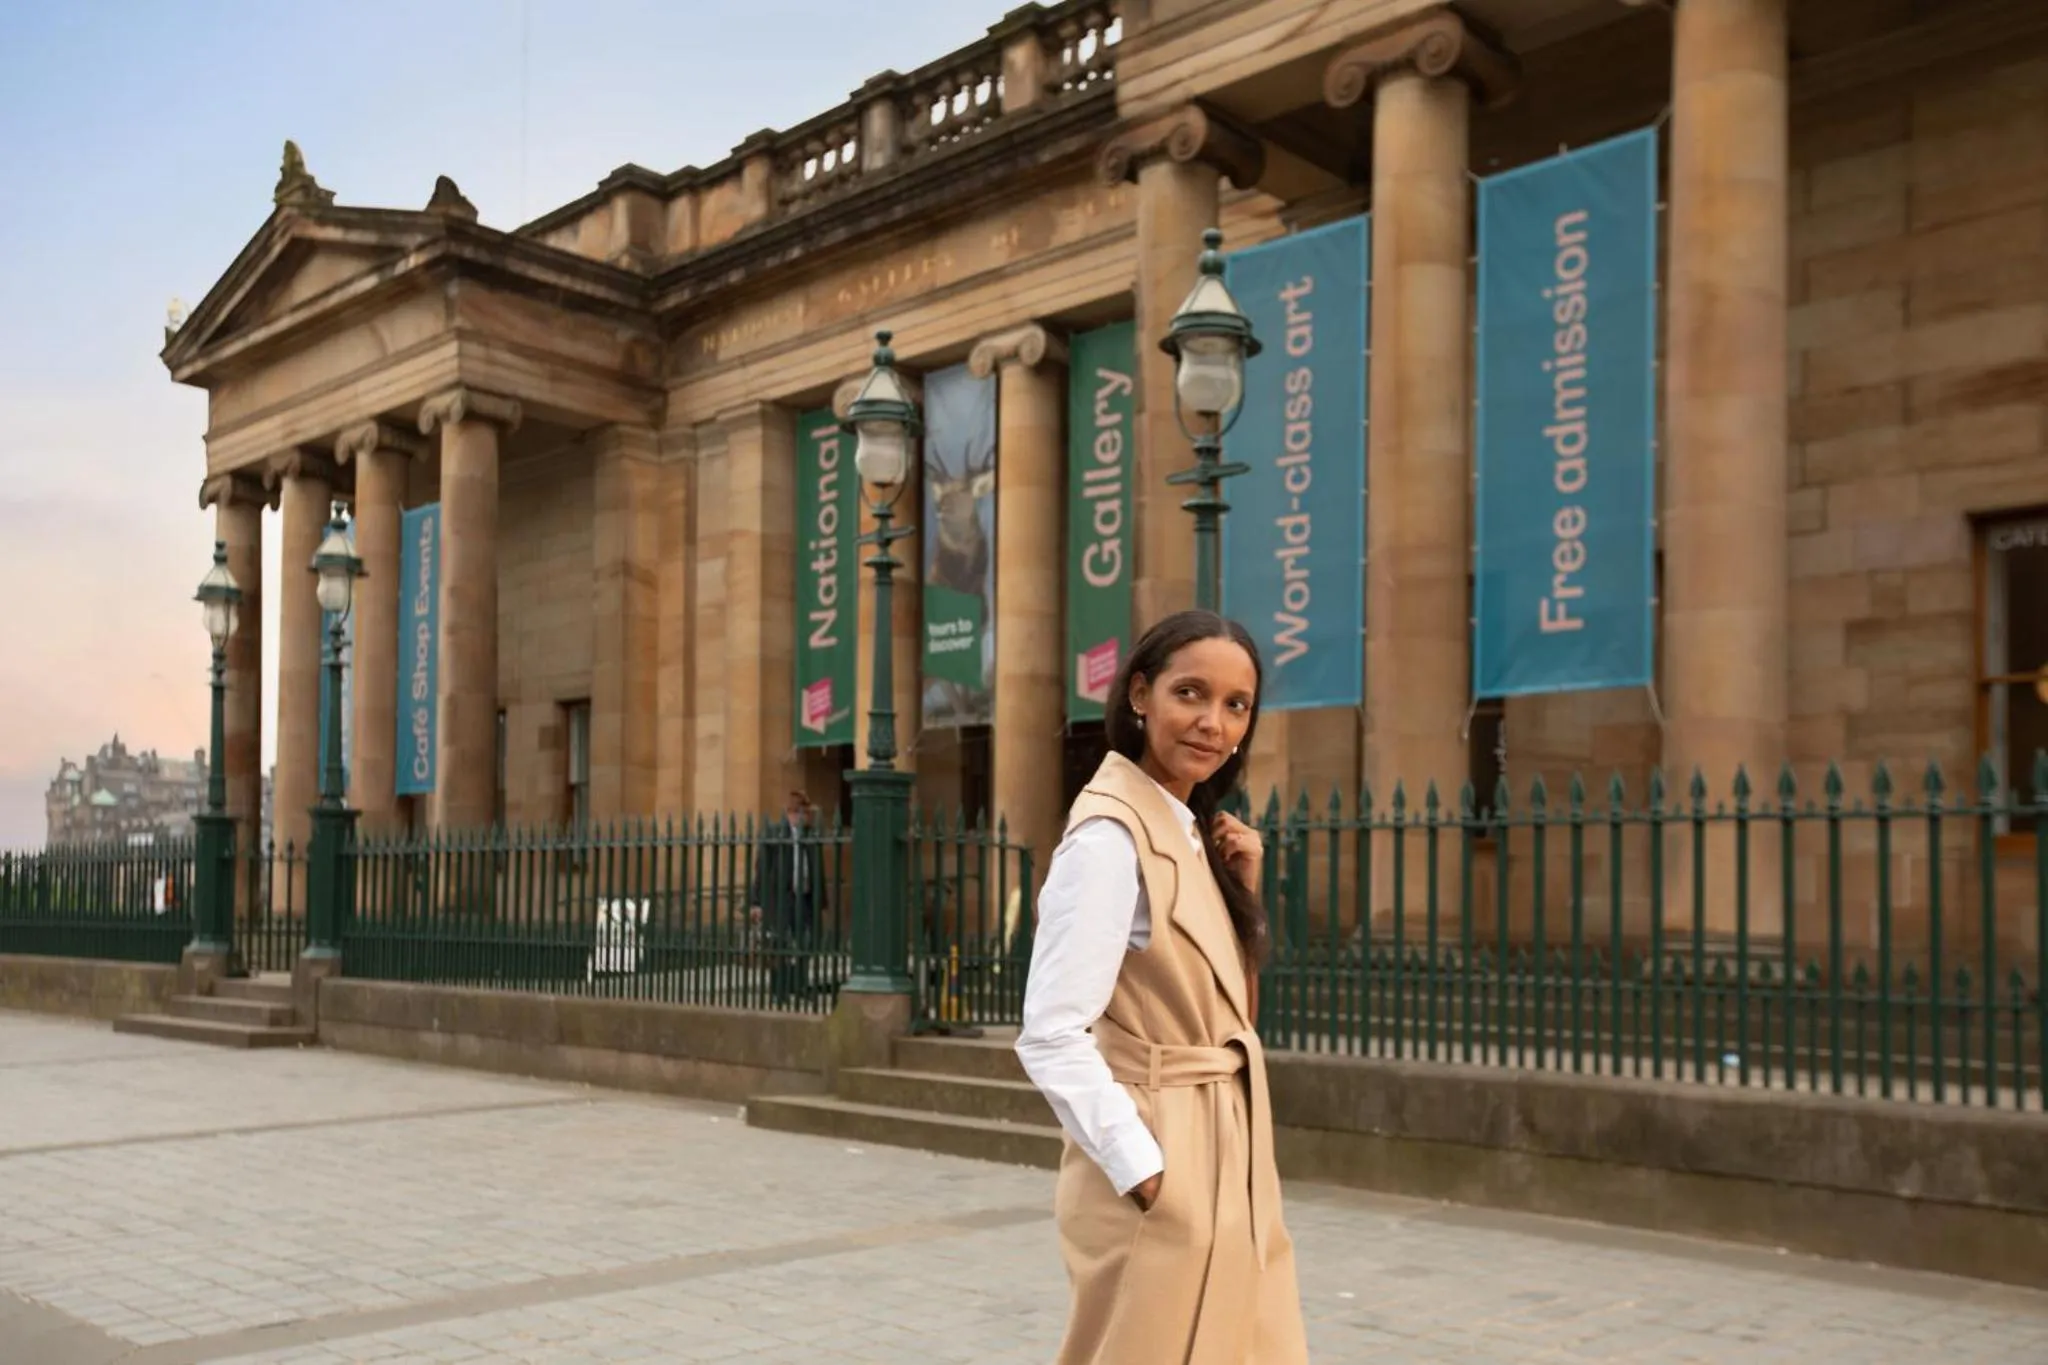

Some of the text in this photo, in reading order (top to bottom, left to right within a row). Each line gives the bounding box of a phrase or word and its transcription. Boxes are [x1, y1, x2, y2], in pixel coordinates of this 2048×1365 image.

[810, 424, 839, 648] National
[1082, 367, 1131, 587] Gallery
[1274, 275, 1313, 666] World-class art
[1539, 209, 1589, 633] Free admission
[413, 516, 433, 780] Café Shop Events
